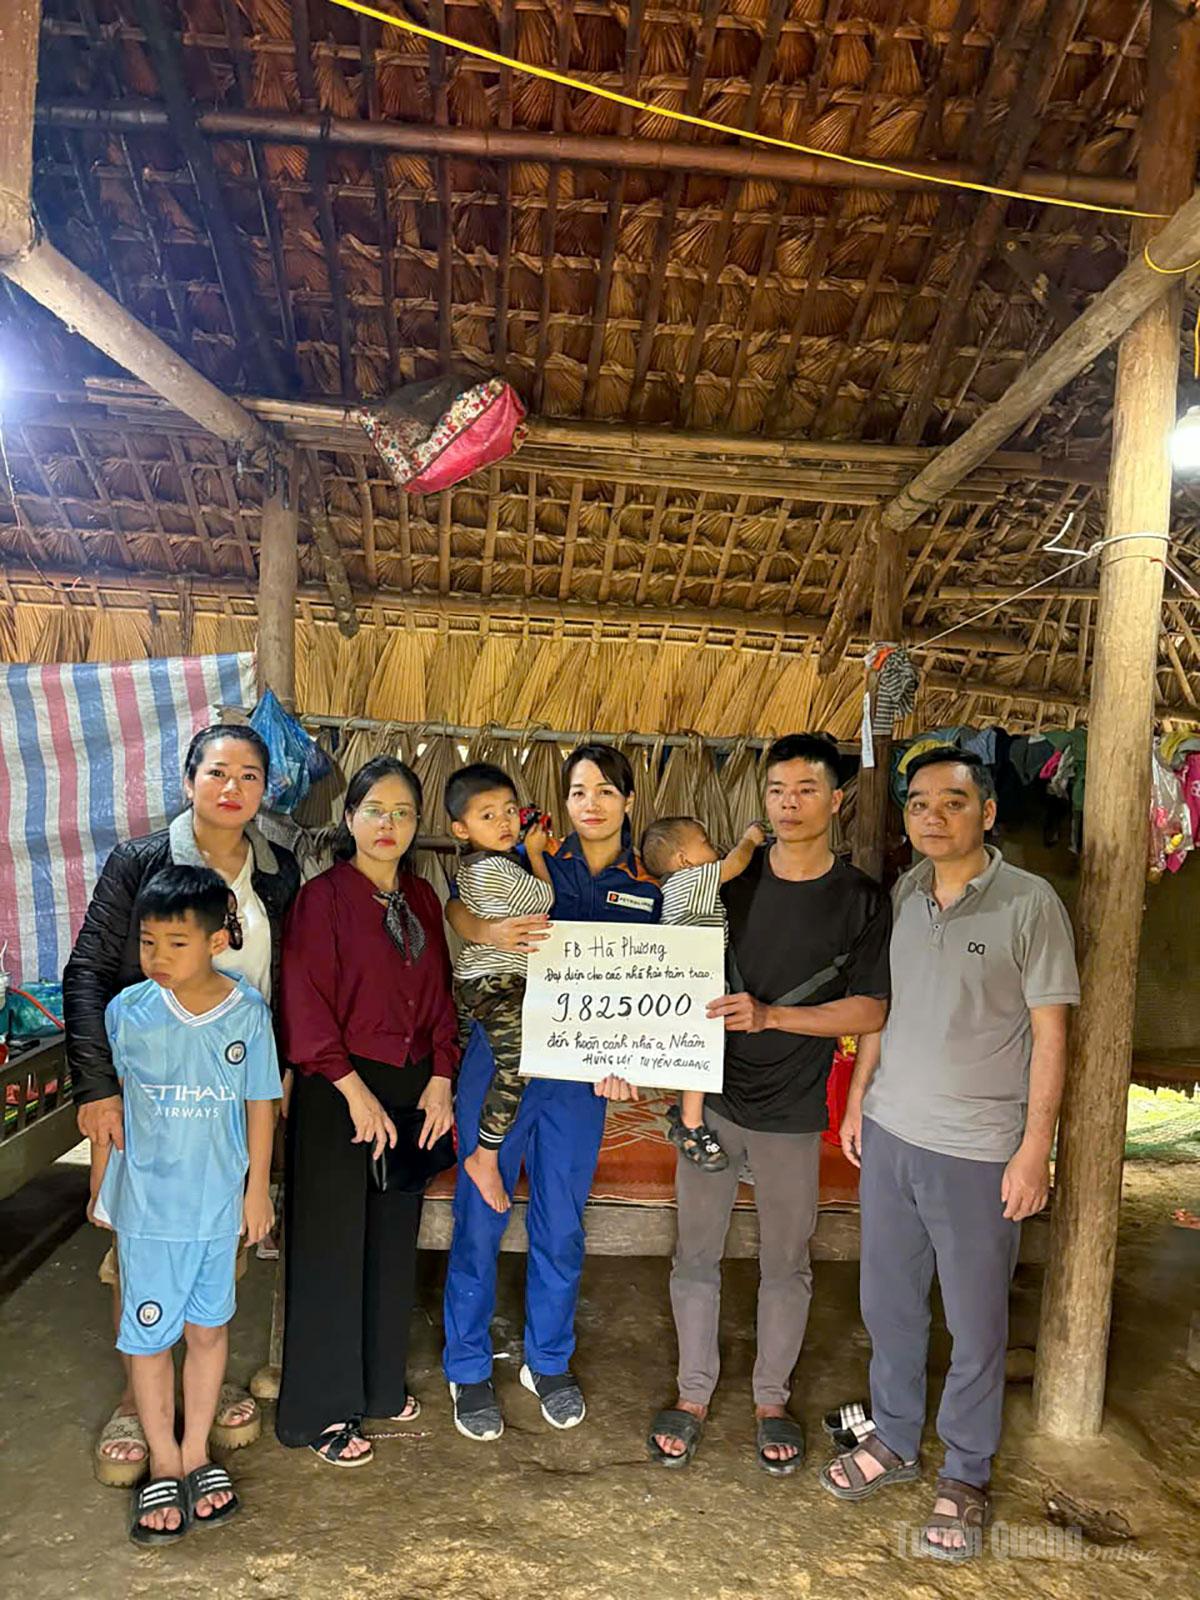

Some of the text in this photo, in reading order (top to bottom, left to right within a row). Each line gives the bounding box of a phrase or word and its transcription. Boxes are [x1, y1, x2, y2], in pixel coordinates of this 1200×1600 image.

[563, 941, 582, 958] FB
[586, 966, 603, 980] cho
[605, 966, 622, 980] các
[547, 1030, 569, 1048] đến
[669, 1032, 706, 1049] Nhâm
[672, 1057, 711, 1071] QUANG
[140, 1083, 236, 1101] ETIHAD
[154, 1104, 220, 1119] AIRWAYS
